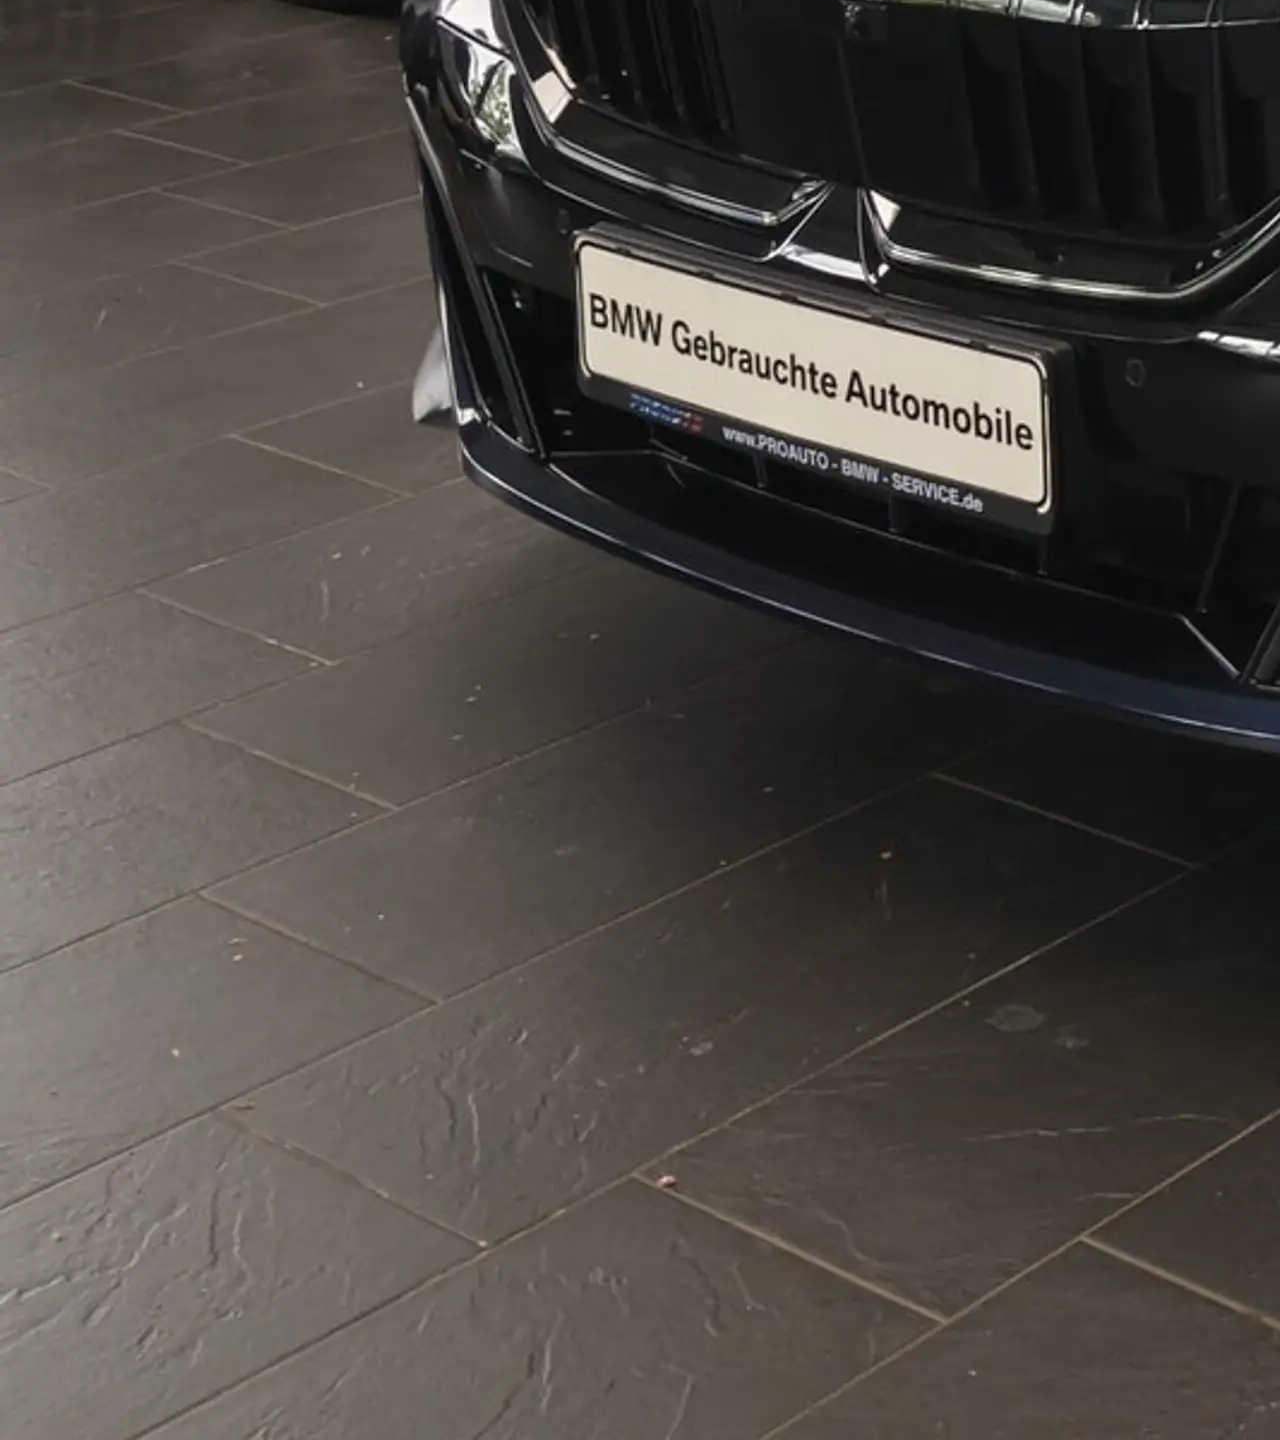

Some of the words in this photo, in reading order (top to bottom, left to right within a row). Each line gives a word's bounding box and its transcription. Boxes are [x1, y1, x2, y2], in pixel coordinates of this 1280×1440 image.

[589, 292, 663, 348] BMW
[671, 319, 838, 399] Gebrauchte
[844, 369, 1034, 451] Automobile
[722, 425, 829, 471] www.PROAUTO
[840, 458, 880, 485] BMW
[891, 471, 983, 513] SERVICE.de
